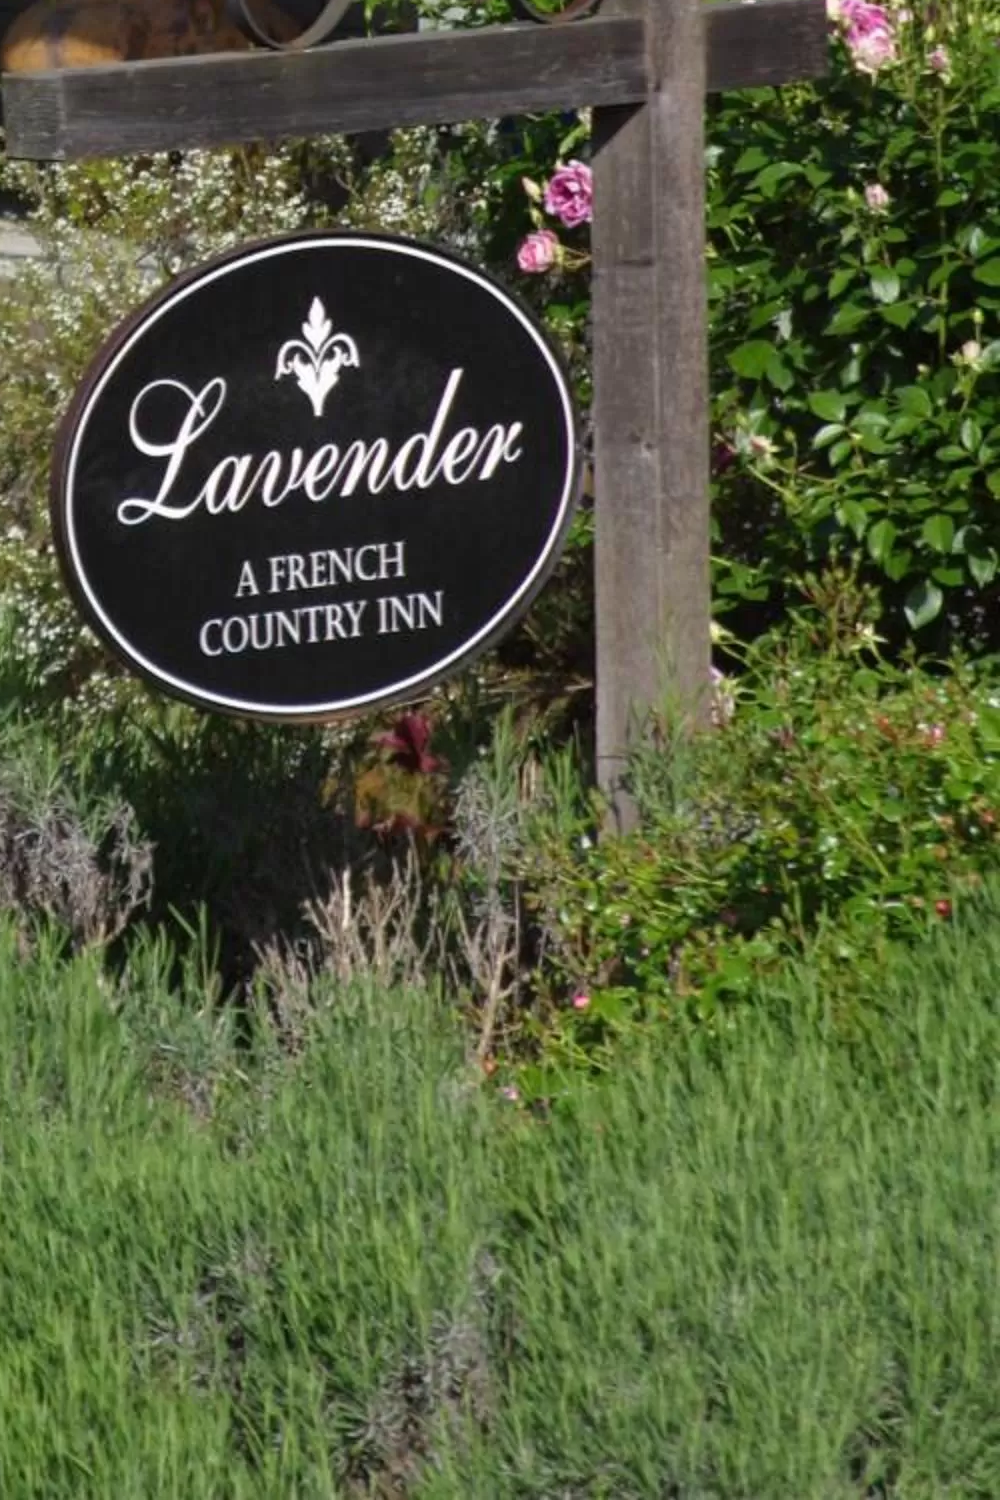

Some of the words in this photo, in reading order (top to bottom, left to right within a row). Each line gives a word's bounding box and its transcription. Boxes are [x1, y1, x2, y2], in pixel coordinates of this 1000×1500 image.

[116, 367, 523, 525] Lavender
[235, 560, 260, 597] A
[269, 541, 406, 593] FRENCH
[199, 600, 367, 656] COUNTRY
[377, 590, 444, 635] INN
